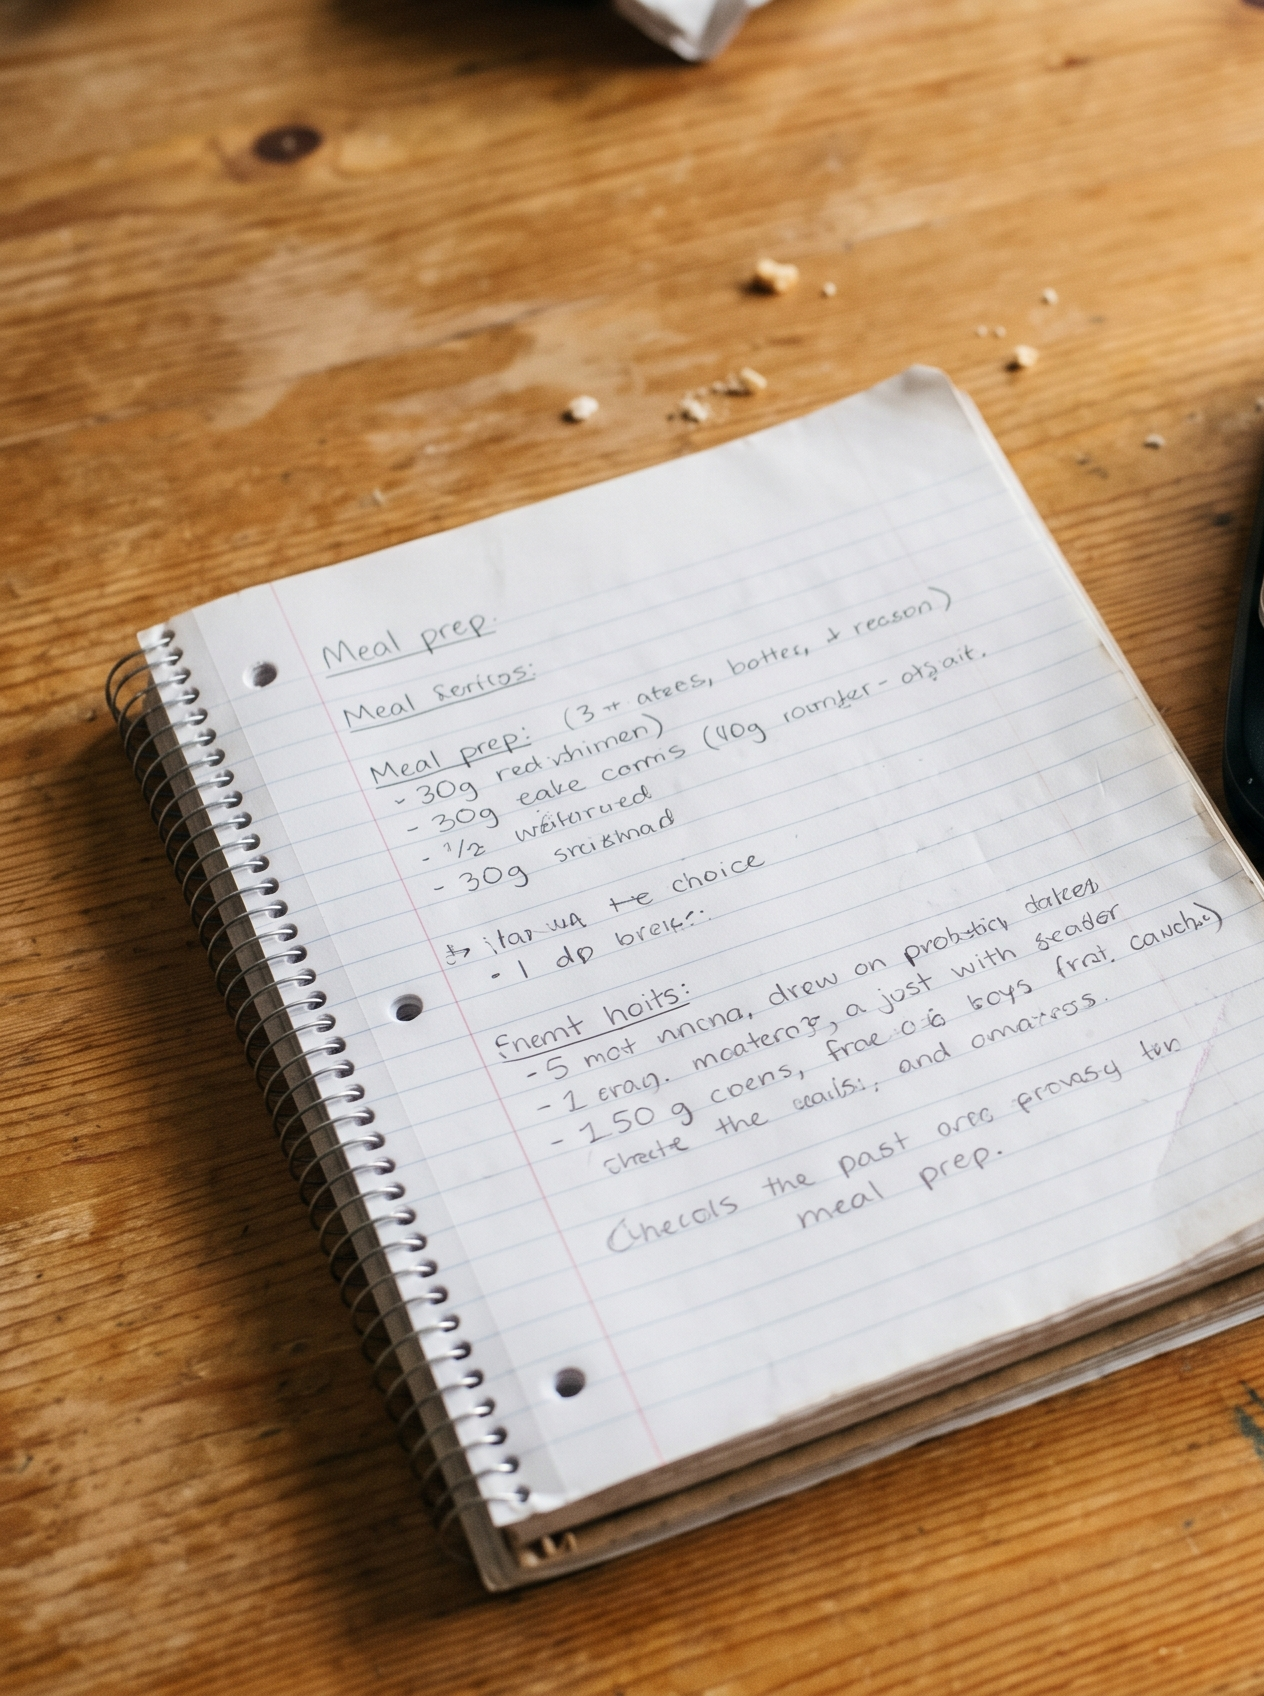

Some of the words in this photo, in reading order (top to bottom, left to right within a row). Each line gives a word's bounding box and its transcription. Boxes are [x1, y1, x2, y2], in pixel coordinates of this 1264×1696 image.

[322, 630, 400, 670] Meal
[343, 694, 416, 728] Meal
[370, 750, 441, 785] Meal
[460, 727, 531, 768] prep:
[416, 779, 478, 804] 30g
[432, 807, 499, 833] 30g
[459, 865, 529, 892] 30g
[672, 854, 765, 894] choice
[768, 973, 838, 1006] drew
[855, 958, 887, 976] on
[877, 972, 932, 1015] just
[951, 947, 1017, 978] with
[715, 1112, 768, 1135] the
[899, 1042, 950, 1074] and
[762, 1173, 815, 1196] the
[838, 1131, 910, 1178] past
[797, 1181, 884, 1229] meal
[918, 1146, 1003, 1191] prep.
